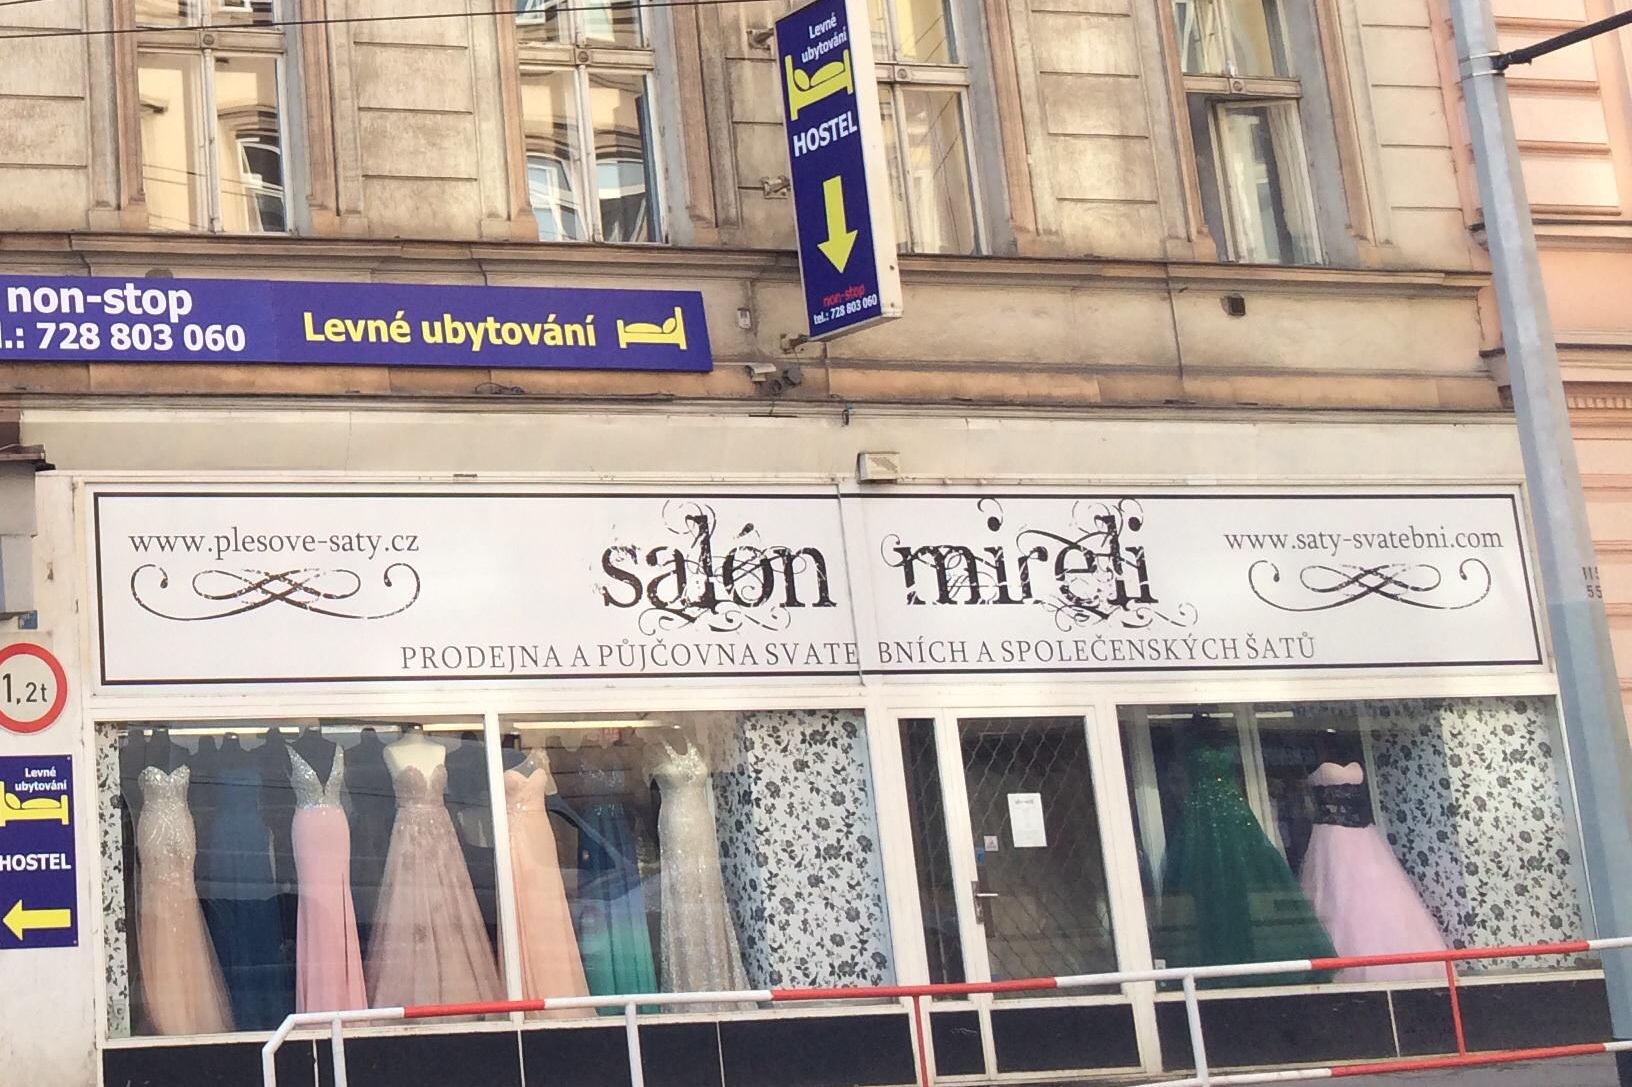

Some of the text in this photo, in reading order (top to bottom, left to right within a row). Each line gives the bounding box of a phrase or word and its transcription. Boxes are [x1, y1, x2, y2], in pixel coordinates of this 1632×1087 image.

[808, 12, 838, 39] Levné
[801, 27, 847, 64] ubytování
[792, 111, 858, 158] HOSTEL
[7, 283, 193, 323] non-stop
[814, 294, 878, 325] tel.: 728 803 060
[822, 284, 865, 307] non-stop
[36, 322, 101, 351] 728
[110, 323, 174, 351] 803
[183, 324, 246, 352] 060
[303, 310, 597, 352] Levné ubytování
[127, 527, 420, 558] www.plesove-saty.cz
[1223, 524, 1504, 557] www.saty-svatebni.com
[600, 509, 839, 615] salón
[400, 644, 564, 672] PRODEJNA
[569, 644, 592, 667] A
[598, 637, 760, 672] PŮJČOVNA
[975, 640, 996, 664] A
[1001, 633, 1240, 664] SPOLEČENSKÝCH
[1245, 631, 1316, 660] ŠATŮ
[14, 778, 68, 793] ubytování
[24, 766, 56, 779] Levné
